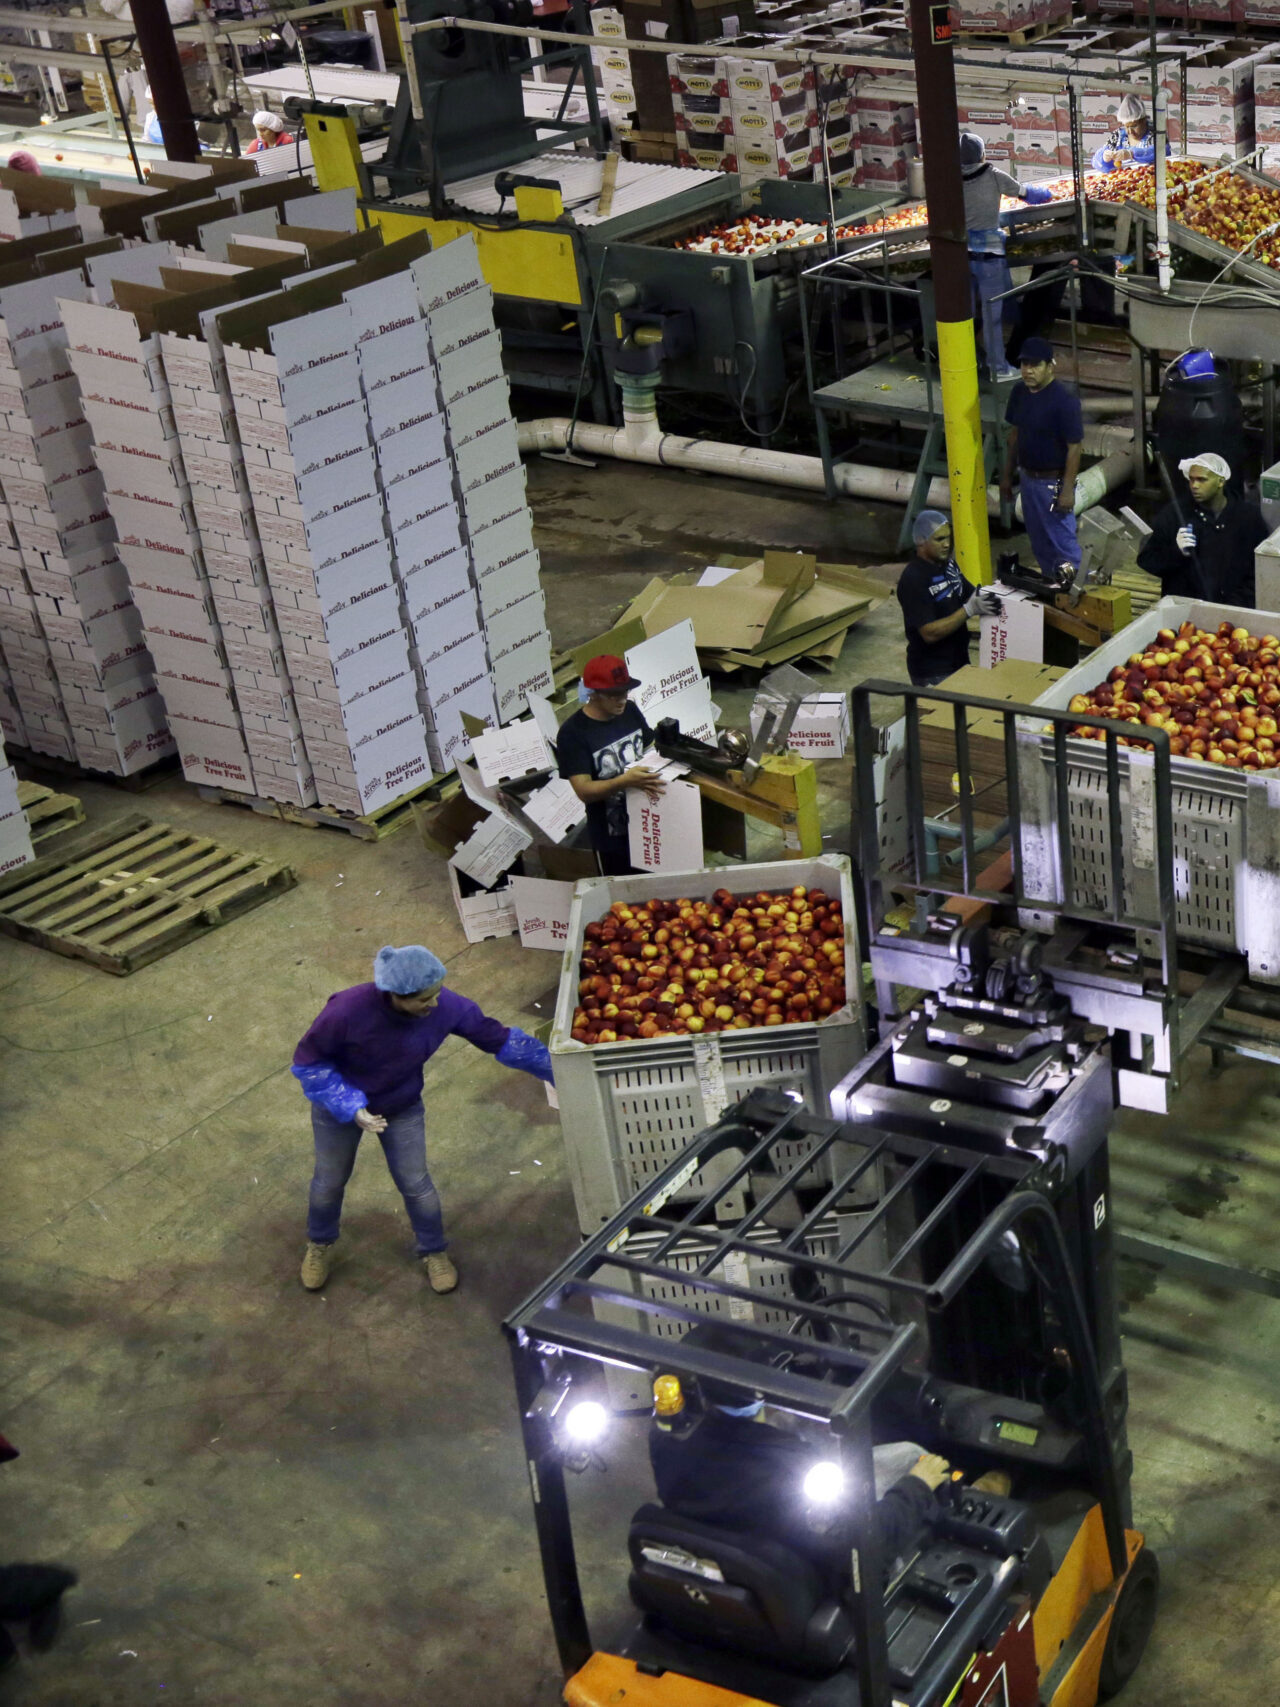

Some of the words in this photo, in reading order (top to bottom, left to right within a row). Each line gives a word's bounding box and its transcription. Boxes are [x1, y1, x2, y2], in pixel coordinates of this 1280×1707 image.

[446, 278, 479, 300] Delicious
[379, 315, 415, 335] Delicious
[458, 327, 490, 347] Delicious
[484, 461, 516, 483] Delicious
[145, 539, 185, 555] Delicious
[991, 625, 999, 647] Tree
[182, 674, 220, 688] Delicious
[453, 673, 484, 695] Delicious
[518, 671, 548, 692] Delicious
[533, 677, 550, 692] Fruit
[660, 665, 695, 688] Delicious
[661, 686, 678, 699] Tree
[680, 673, 699, 690] Fruit
[376, 714, 413, 736] Delicious
[787, 731, 831, 739] Delicious
[808, 739, 835, 747] Fruit
[204, 757, 242, 772] Delicious
[204, 765, 223, 777] Tree
[224, 770, 247, 781] Fruit
[385, 756, 422, 780] Delicious
[385, 776, 404, 790] Tree
[405, 763, 426, 780] Fruit
[641, 808, 650, 833] Tree
[651, 813, 661, 866] Delicious
[643, 836, 652, 866] Fruit
[1096, 1200, 1104, 1222] 2
